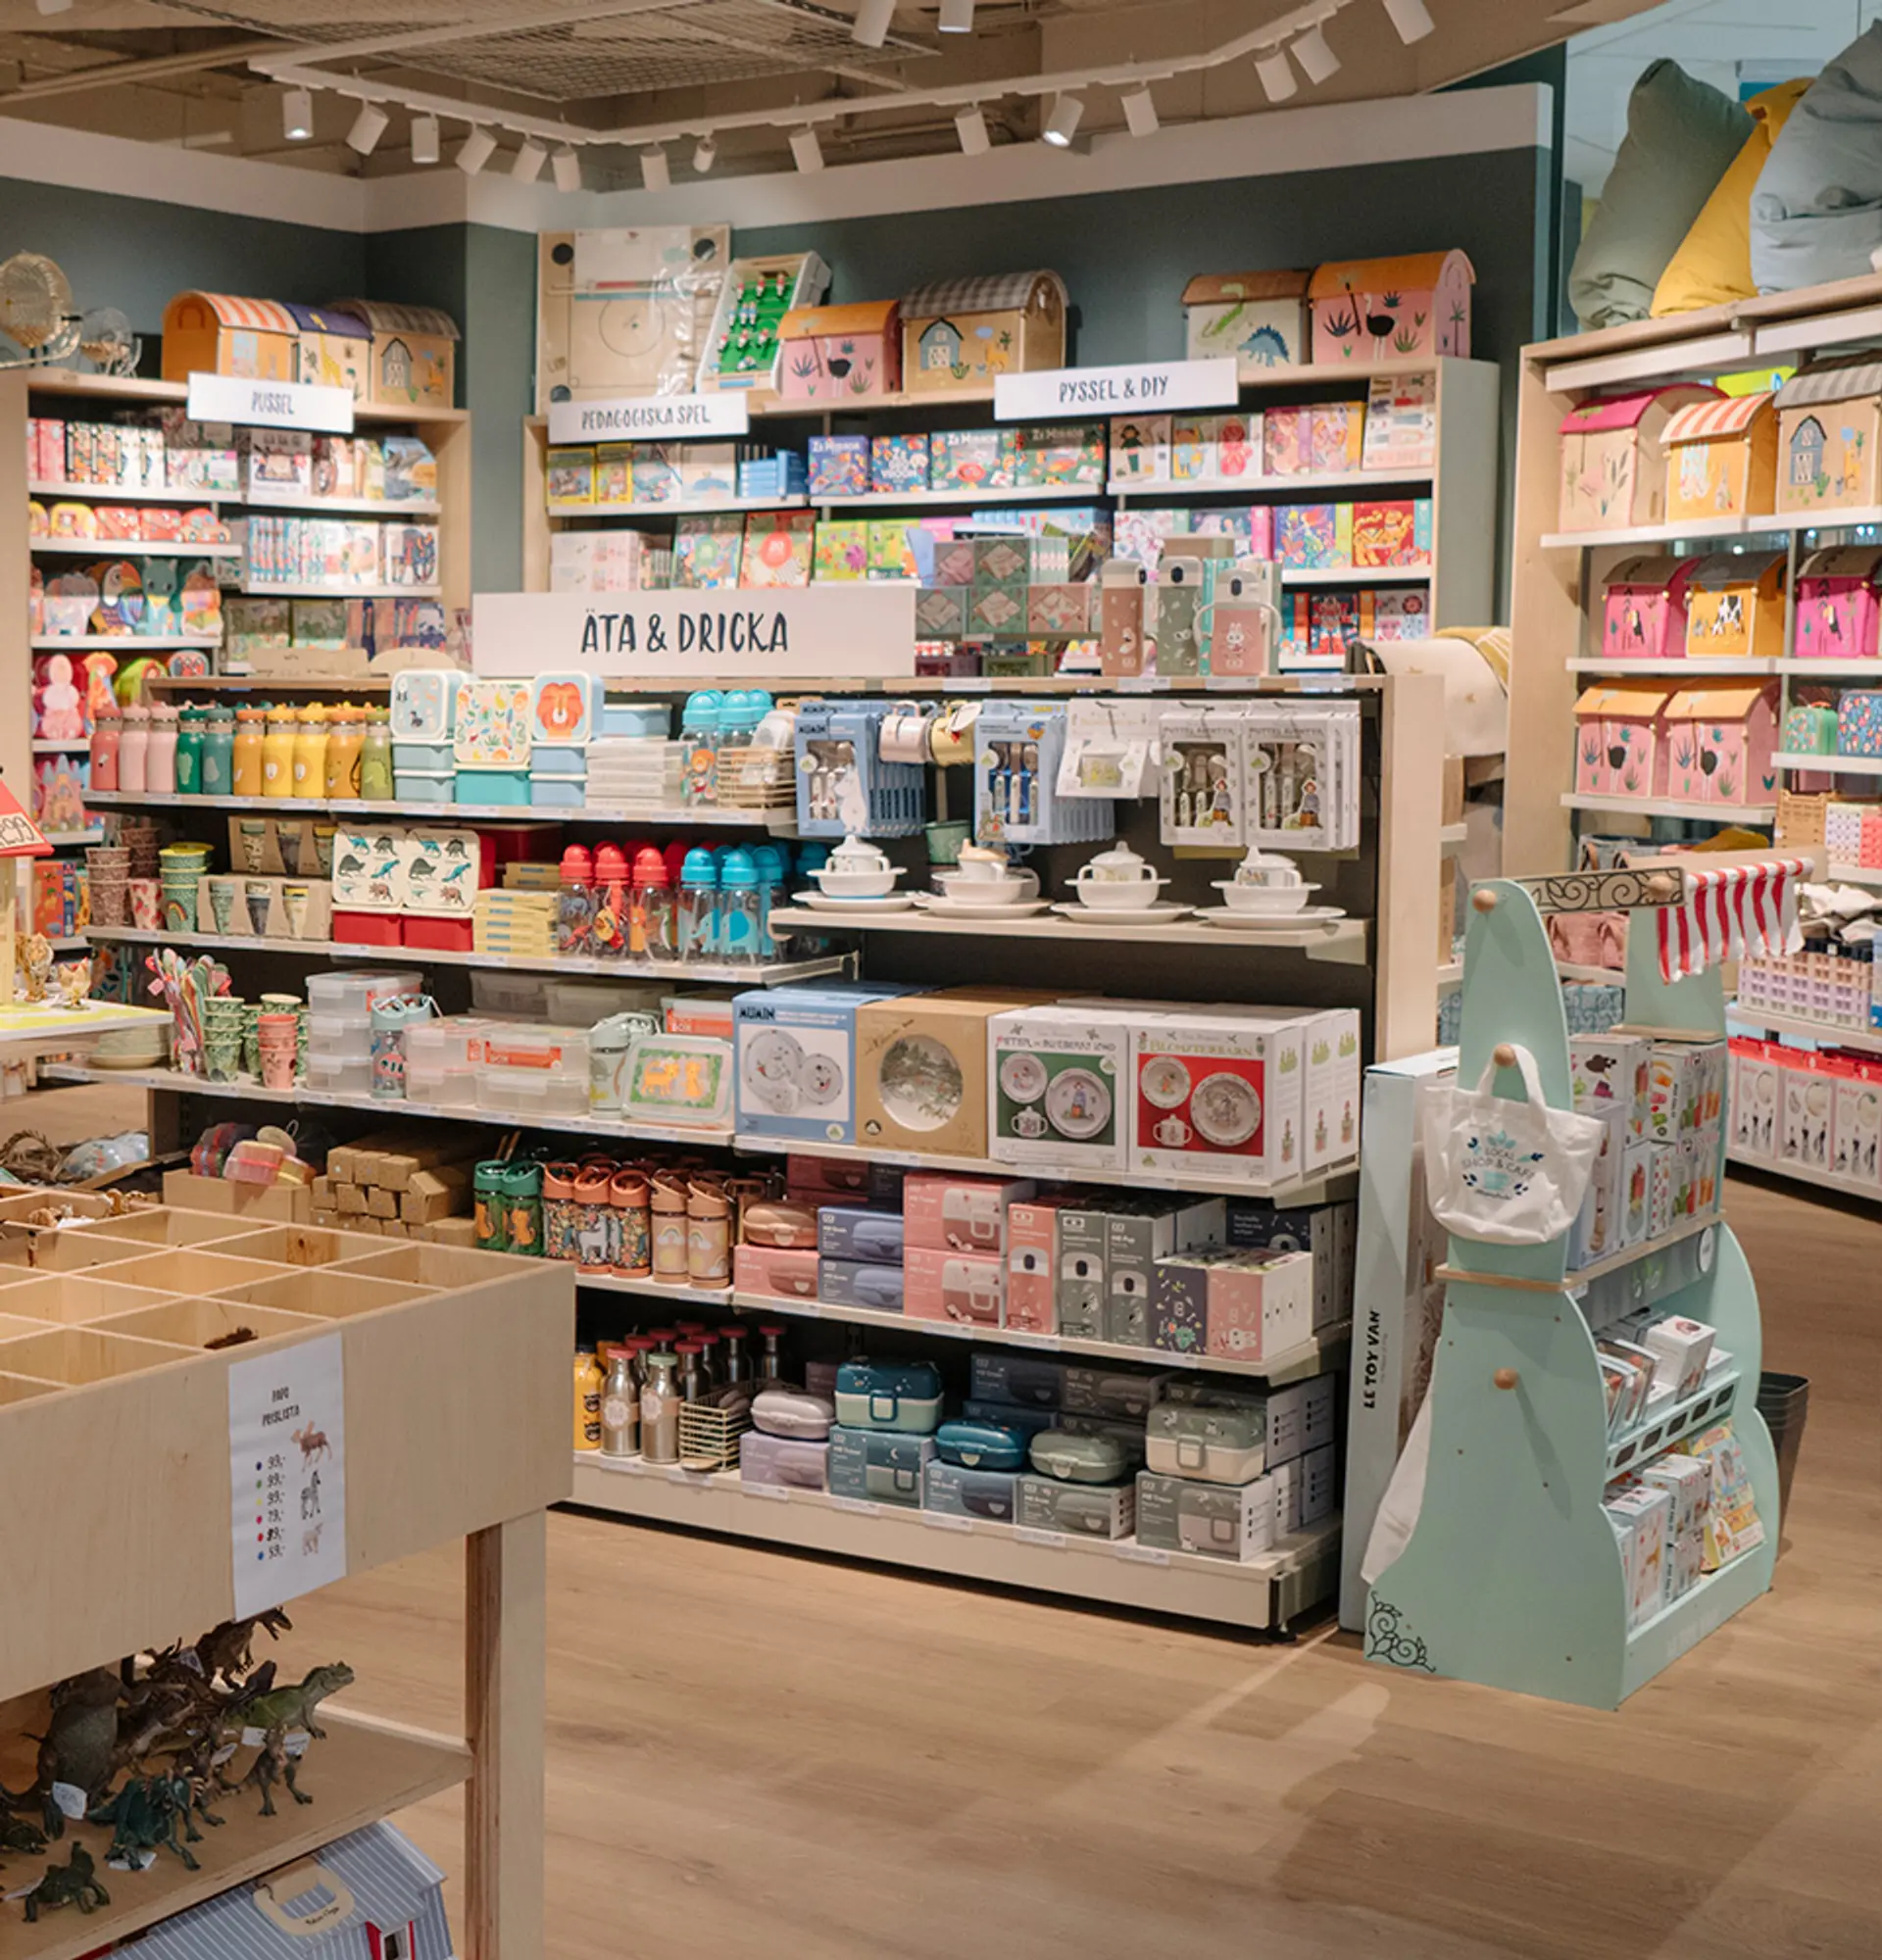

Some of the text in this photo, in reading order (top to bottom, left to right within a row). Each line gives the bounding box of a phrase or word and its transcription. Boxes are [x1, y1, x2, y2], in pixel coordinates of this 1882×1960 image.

[1059, 375, 1168, 403] PYSSEL & DIY
[251, 391, 295, 415] PUSSEL
[677, 404, 711, 424] SPEL
[580, 608, 788, 654] ÄTA & DRICKA
[1362, 1309, 1381, 1409] LE TOY VAN
[262, 1404, 300, 1427] PRISLISTA
